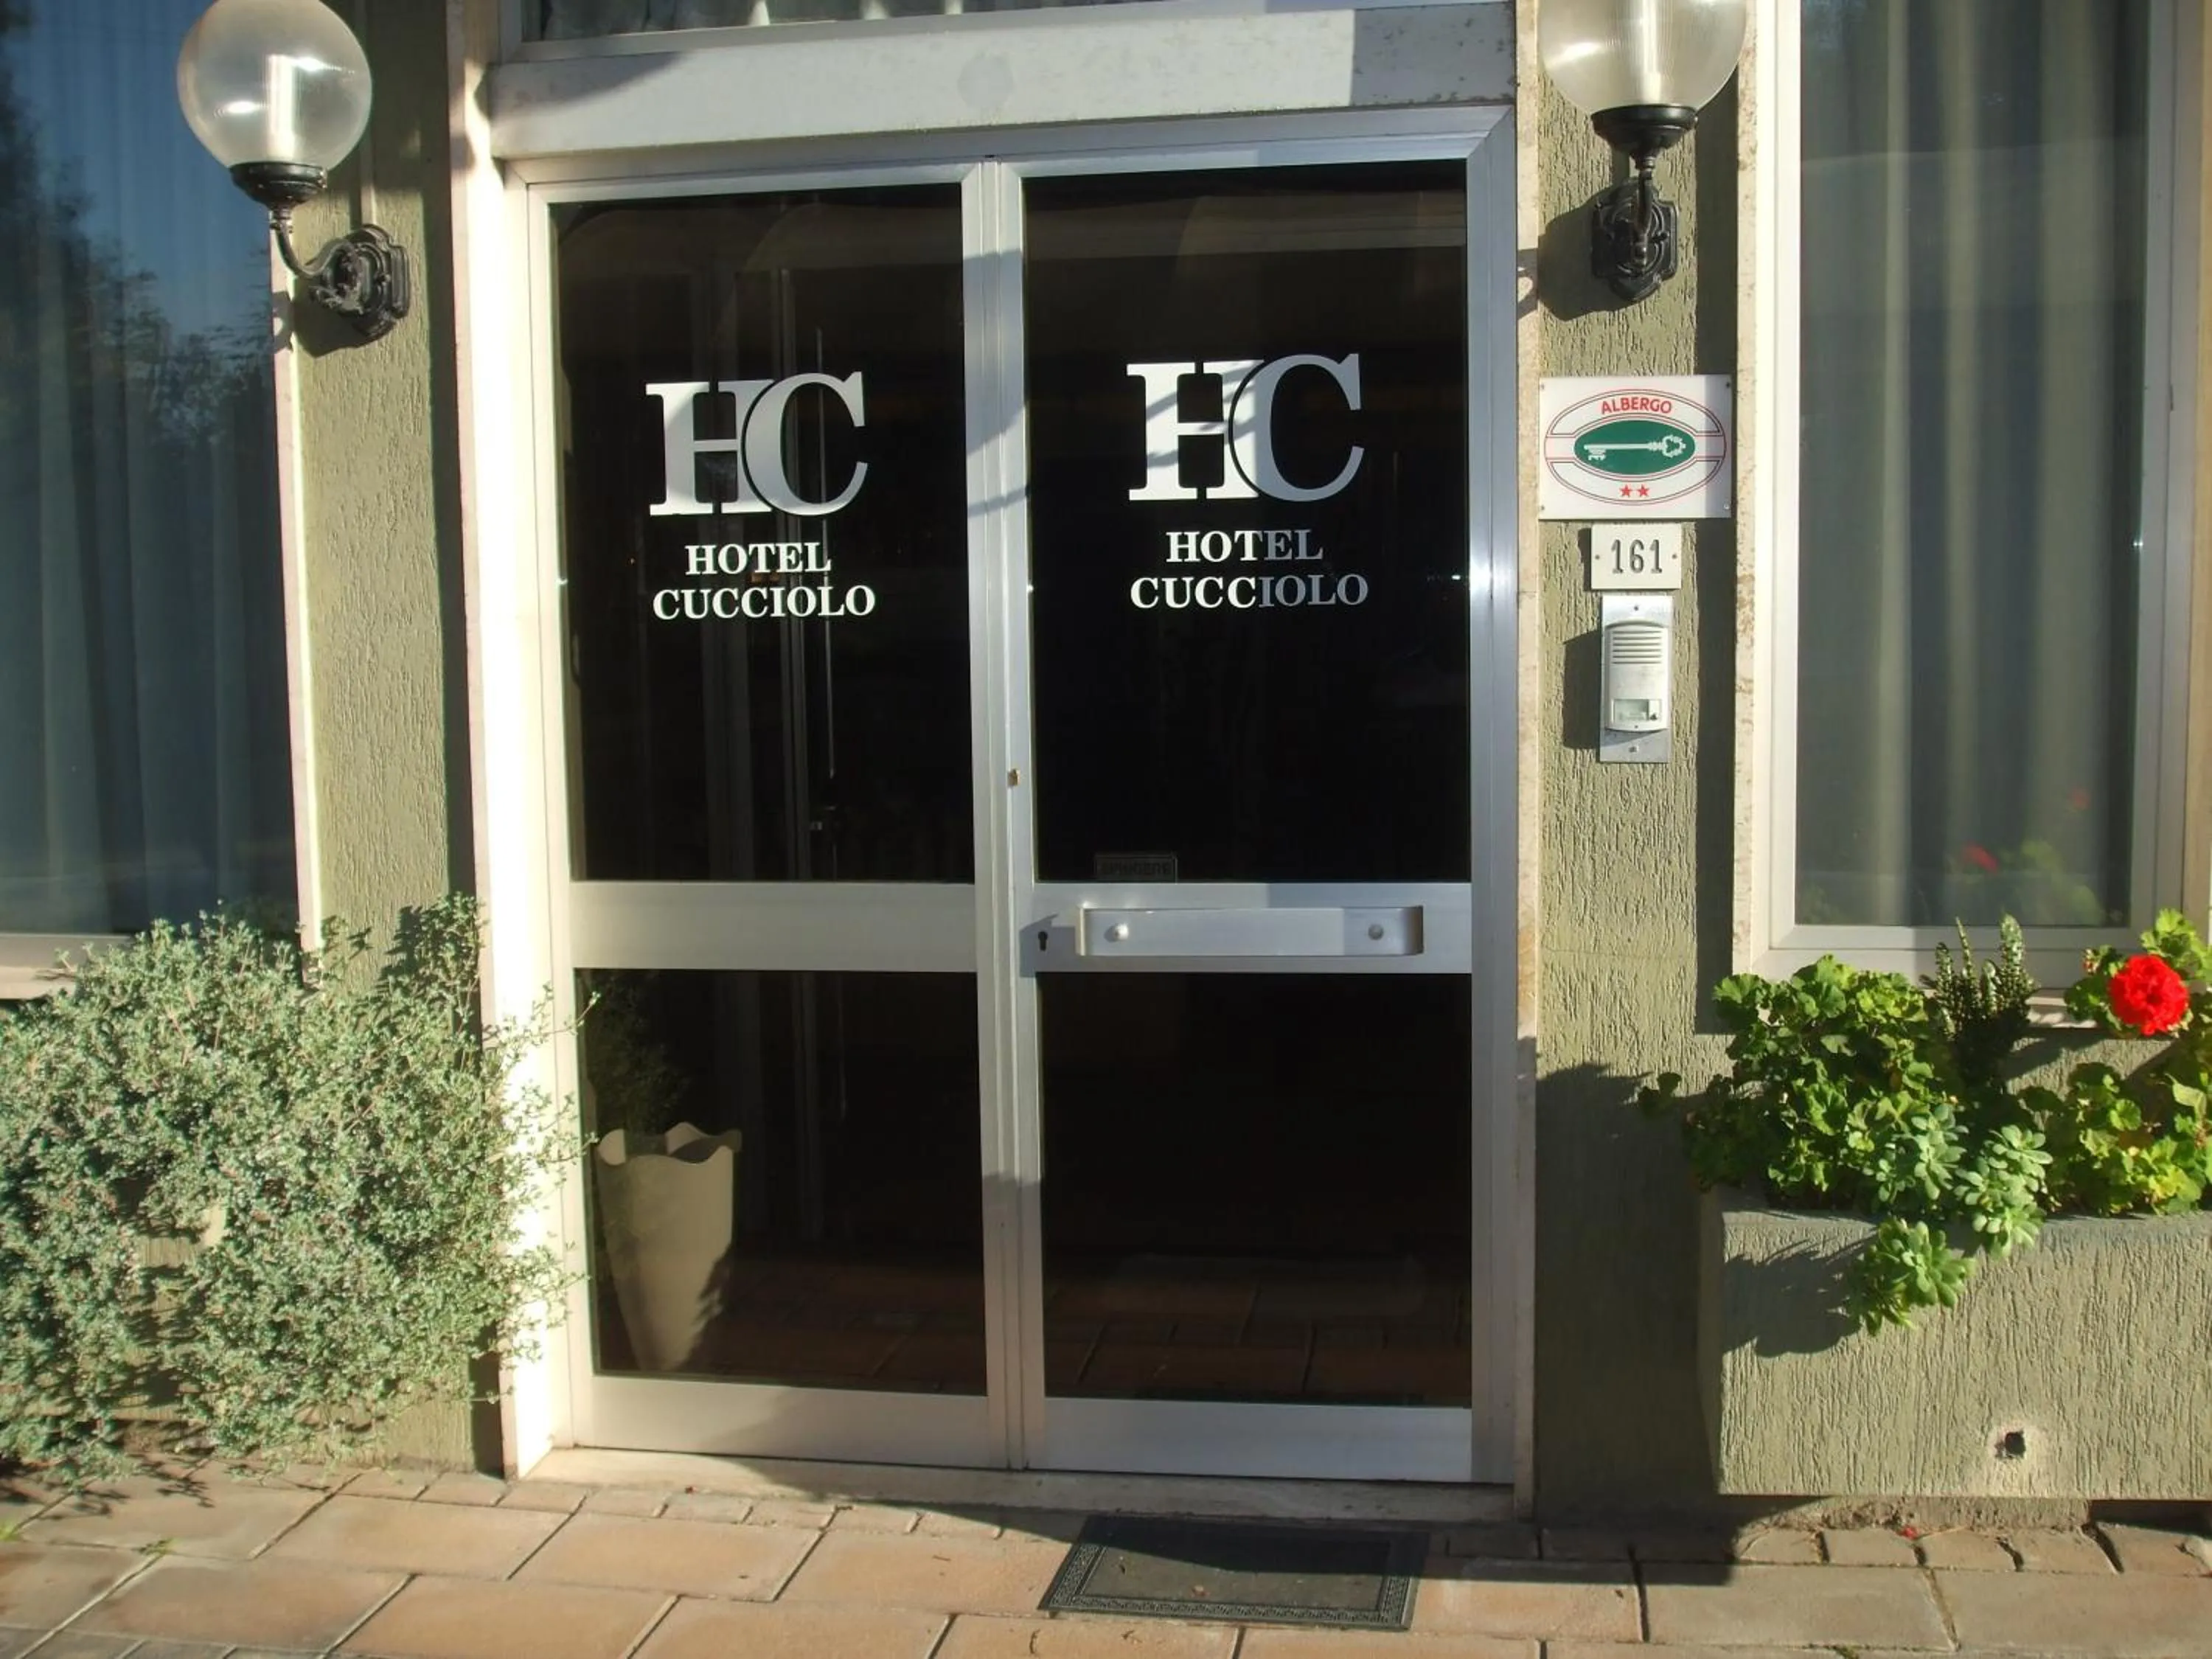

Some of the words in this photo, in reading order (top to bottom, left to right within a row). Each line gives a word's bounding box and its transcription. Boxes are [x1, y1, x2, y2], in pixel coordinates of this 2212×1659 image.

[1601, 397, 1672, 414] ALBERGO
[646, 371, 868, 515] HC
[1127, 353, 1365, 502] HC
[685, 542, 832, 575] HOTEL
[1166, 529, 1324, 563] HOTEL
[1610, 539, 1663, 574] 161
[653, 585, 875, 620] CUCCIOLO
[1130, 574, 1369, 608] CUCCIOLO
